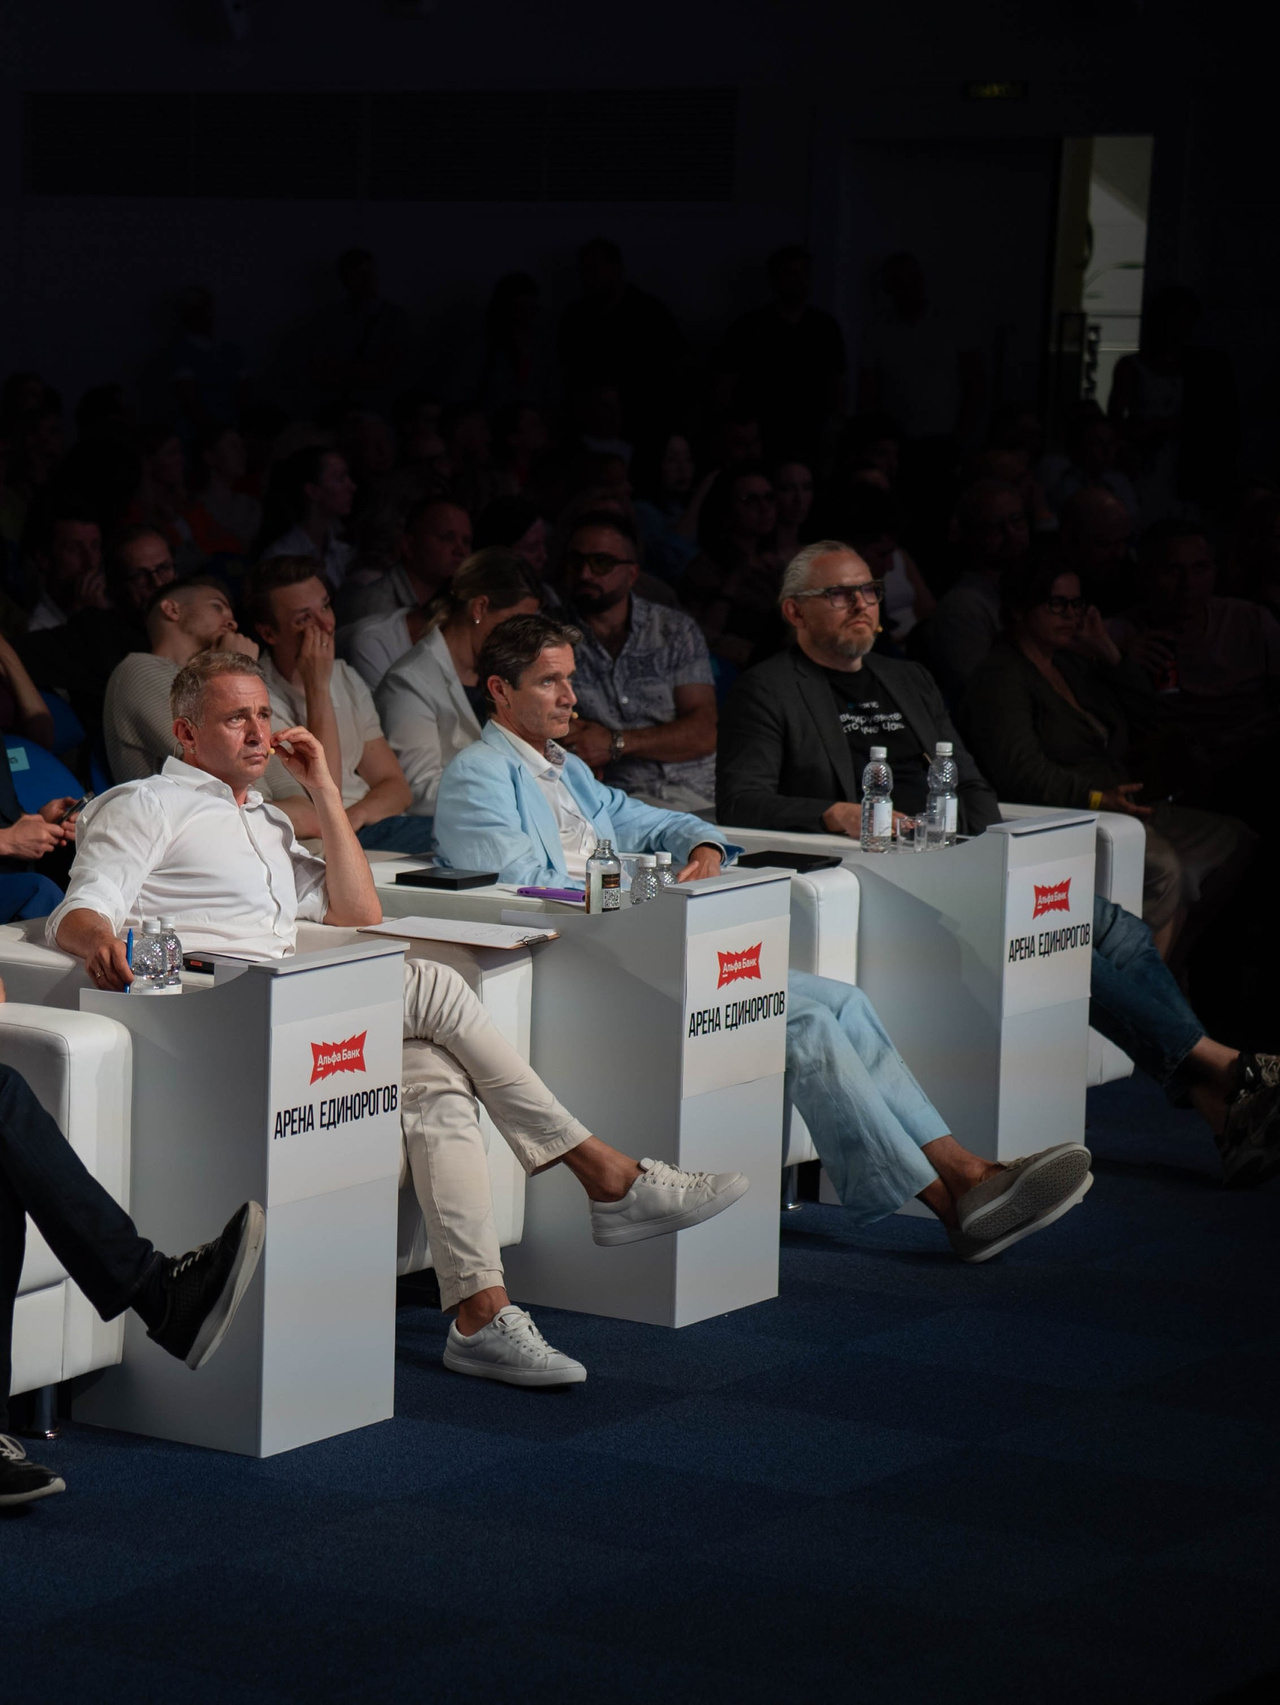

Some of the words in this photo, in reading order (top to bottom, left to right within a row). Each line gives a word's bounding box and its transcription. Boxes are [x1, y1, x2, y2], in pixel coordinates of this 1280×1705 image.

[1008, 935, 1036, 963] АРЕНА
[1039, 923, 1090, 958] ЕДИНОРОГОВ
[688, 1007, 721, 1038] АРЕНА
[725, 991, 785, 1031] ЕДИНОРОГОВ
[317, 1052, 341, 1066] Альфа
[342, 1048, 360, 1060] Банк
[274, 1104, 314, 1140] АРЕНА
[320, 1084, 398, 1130] ЕДИНОРОГОВ
